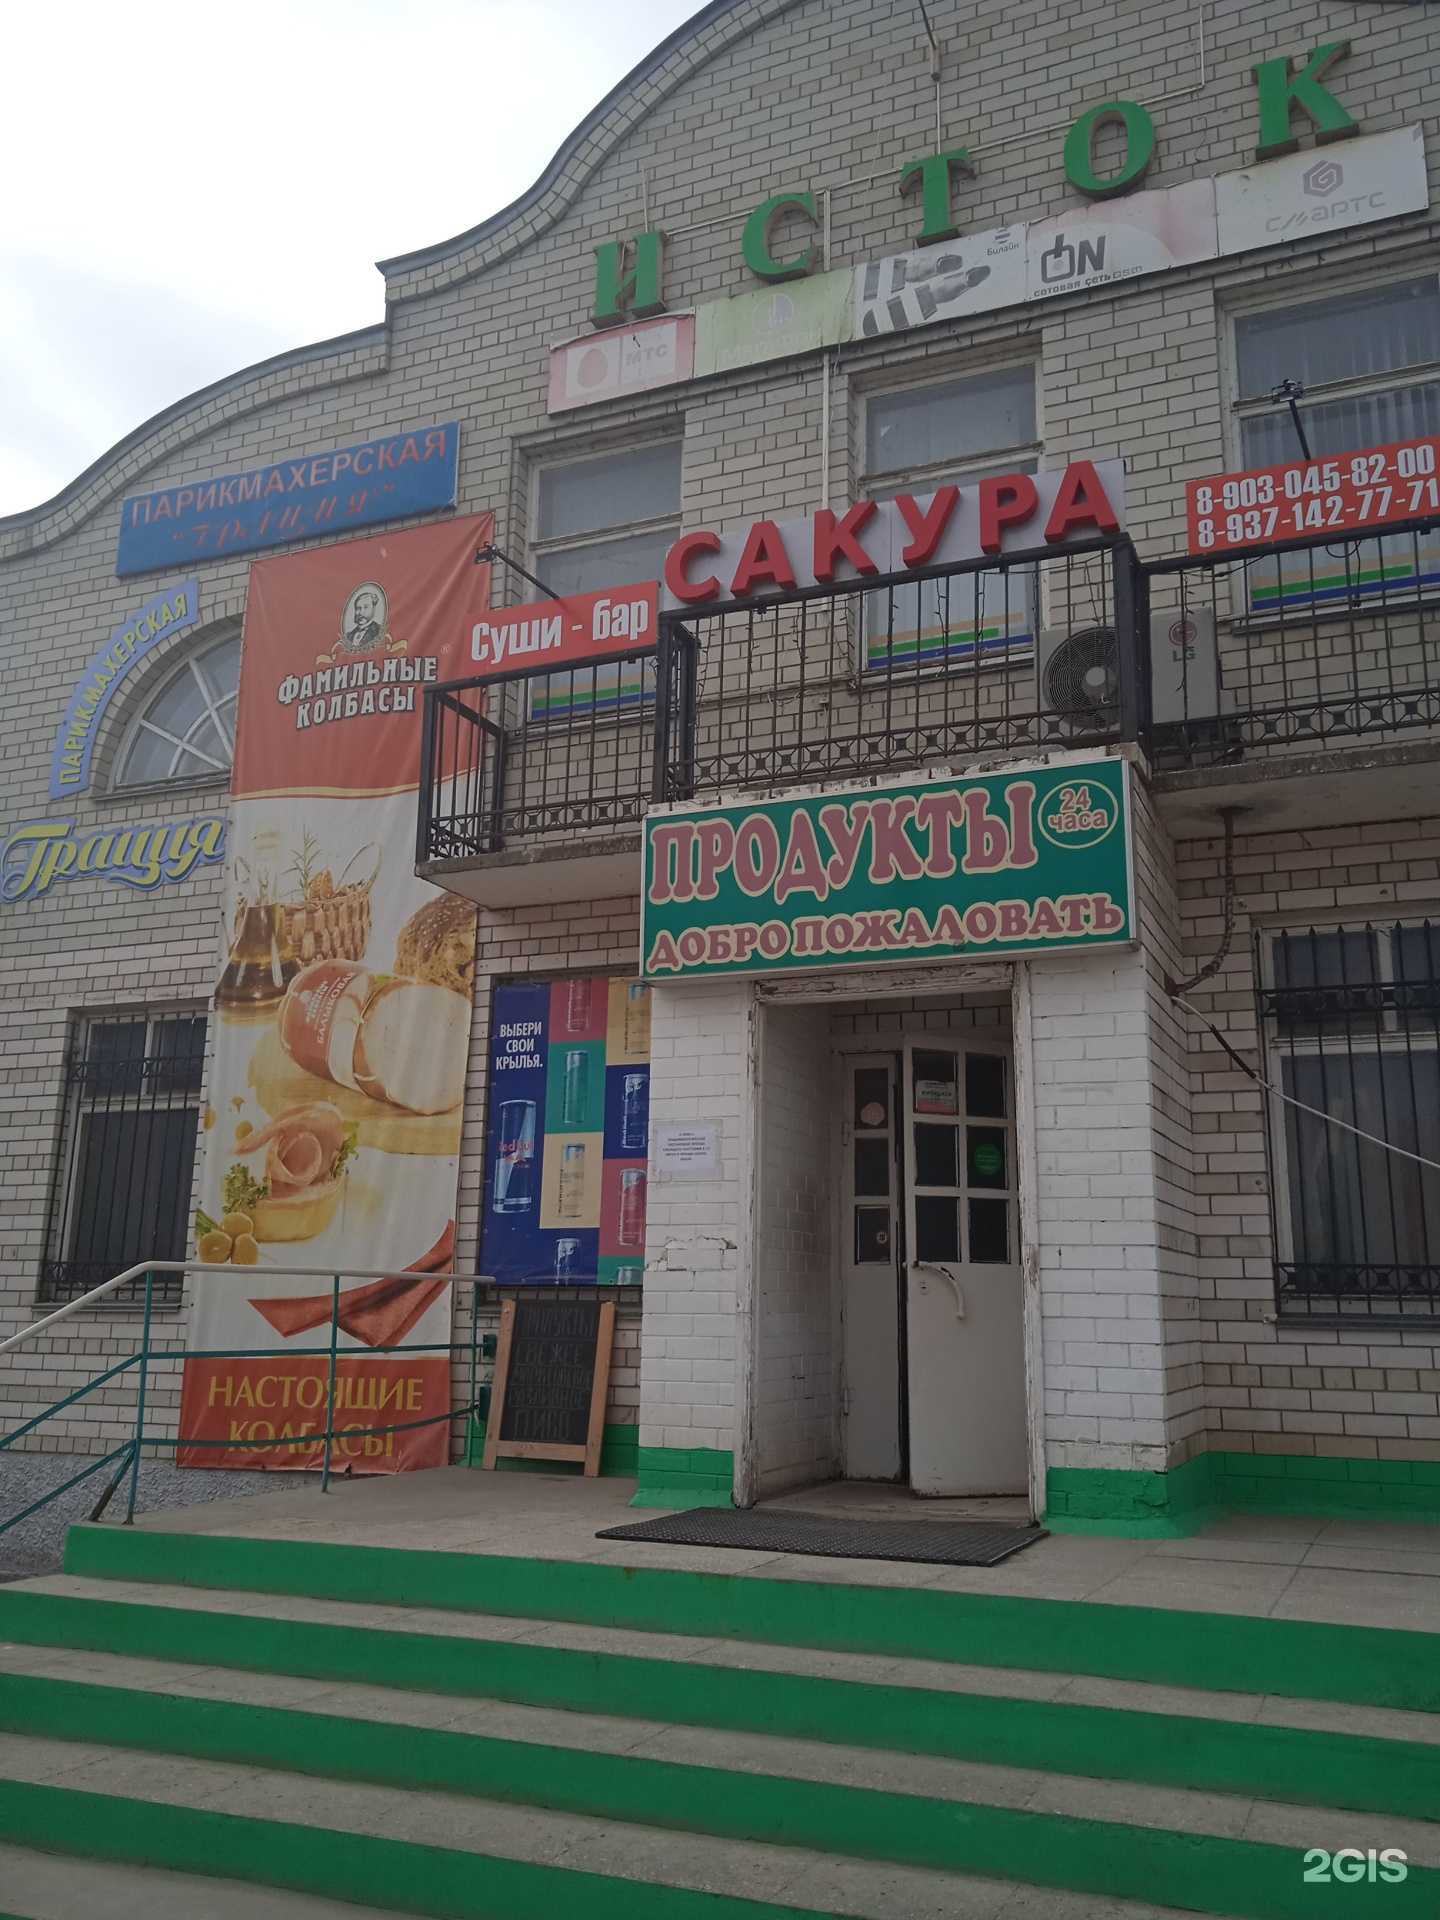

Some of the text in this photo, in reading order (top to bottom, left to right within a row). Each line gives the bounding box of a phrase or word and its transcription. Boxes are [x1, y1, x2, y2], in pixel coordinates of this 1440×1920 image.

[590, 40, 1360, 327] ИСТОК
[131, 430, 447, 528] ПАРИКМАХЕРСКАЯ
[1196, 444, 1436, 516] 8-903-045-82-00
[664, 459, 1121, 606] САКУРА
[1198, 477, 1440, 549] 8-937-142-77-71
[471, 614, 563, 665] Суши
[591, 598, 649, 642] бар
[59, 592, 189, 785] ПАРИКМАХЕРСКАЯ
[278, 655, 440, 706] ФАМИЛЬНЫЕ
[296, 684, 418, 730] КОЛБАСЫ
[1047, 808, 1108, 834] часа
[1059, 785, 1092, 813] 24
[647, 780, 1040, 906] ПРОДУКТЫ
[646, 892, 1126, 974] ДОБРО ПОЖАЛОВАТЬ
[495, 1053, 544, 1071] КРЫЛЬЯ.
[499, 1021, 542, 1038] ВЫБЕРИ
[505, 1038, 535, 1054] СВОИ
[207, 1374, 424, 1411] НАСТОЯЩИЕ
